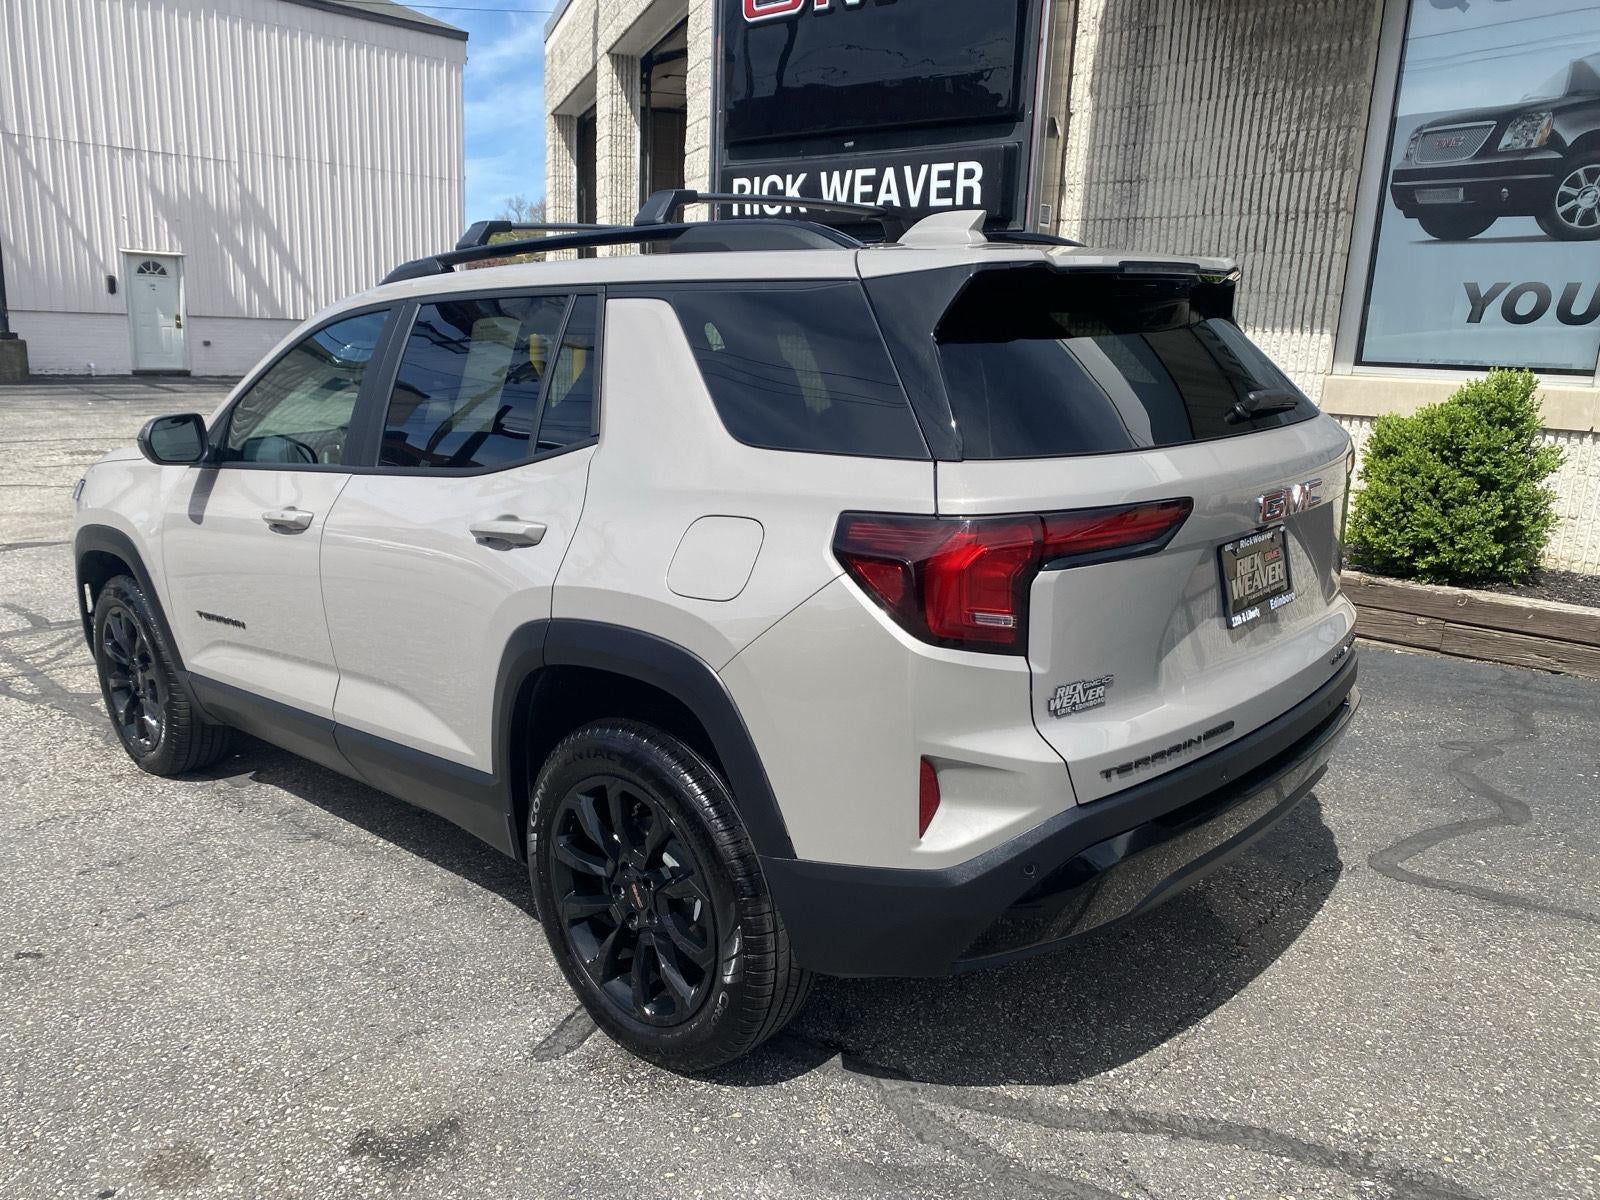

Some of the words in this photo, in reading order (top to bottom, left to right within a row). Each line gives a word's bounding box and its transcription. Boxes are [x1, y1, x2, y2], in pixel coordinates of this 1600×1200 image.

[732, 173, 807, 217] RICK
[820, 160, 984, 208] WEAVER
[1463, 281, 1600, 326] YOU
[1260, 478, 1323, 522] GMC
[1232, 560, 1284, 601] WEAVER
[1236, 551, 1262, 578] RICK
[1049, 685, 1105, 711] WEAVER
[1056, 681, 1084, 699] RICK
[1083, 678, 1102, 689] GMC
[1057, 706, 1072, 716] ERIE
